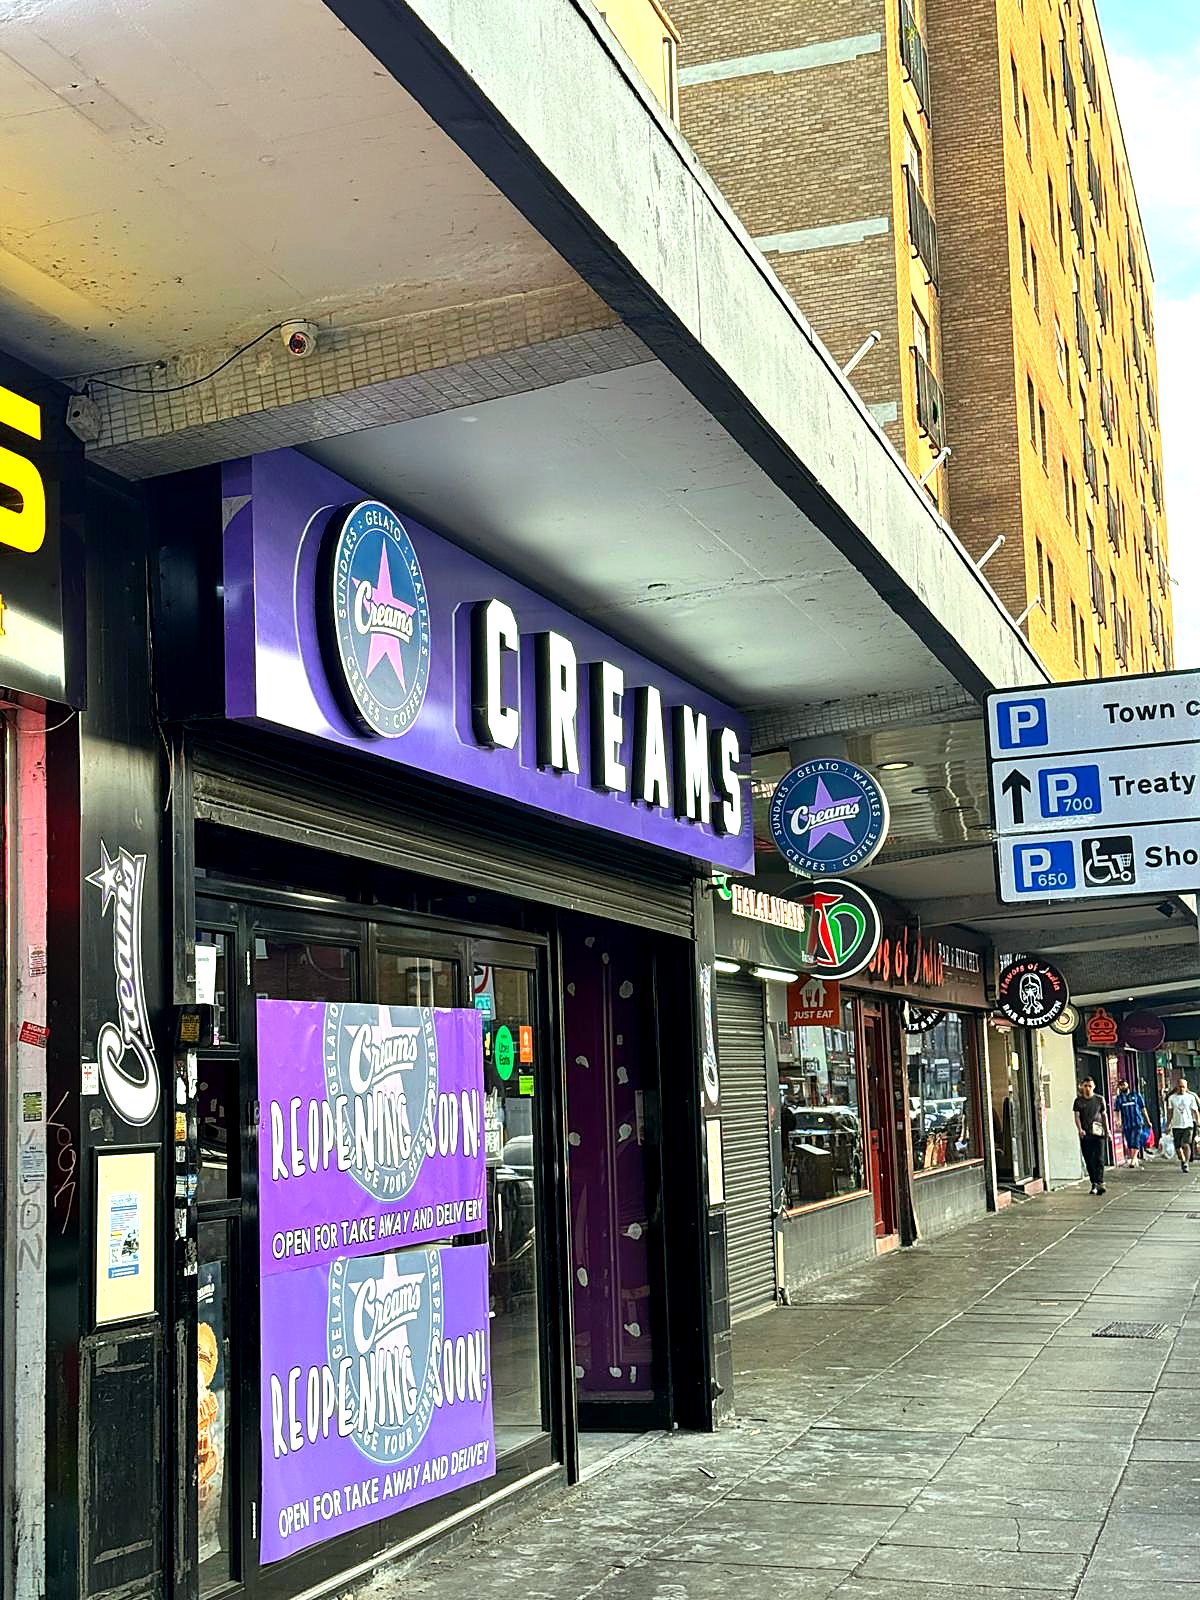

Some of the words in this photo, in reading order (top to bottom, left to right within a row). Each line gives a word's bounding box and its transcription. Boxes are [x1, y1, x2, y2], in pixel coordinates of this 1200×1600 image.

[365, 510, 401, 542] GELATO
[338, 527, 357, 619] SUNDAES
[354, 580, 414, 638] Creams
[410, 559, 428, 657] WAFFLES
[347, 656, 380, 722] CREPES
[393, 682, 423, 729] COFFEE
[485, 598, 743, 836] CREAMS
[1008, 703, 1040, 744] P
[1103, 702, 1175, 724] Town
[797, 763, 839, 778] GELATO
[852, 771, 880, 817] WAFFLES
[1046, 772, 1078, 813] P
[1063, 796, 1093, 811] 700
[1108, 770, 1196, 796] Treaty
[773, 786, 789, 836] SUNDAES
[790, 802, 860, 835] Creams
[786, 849, 825, 871] CREPES
[842, 832, 876, 867] COFFEE
[1021, 847, 1052, 888] P
[1037, 872, 1068, 886] 650
[98, 848, 160, 1126] Creams
[793, 1011, 814, 1021] JUST
[816, 1009, 834, 1019] EAT
[1002, 1003, 1018, 1021] BAR
[1018, 1016, 1025, 1025] &
[1026, 1000, 1062, 1026] KITCHEN
[327, 1003, 339, 1096] GELATO
[349, 1023, 418, 1094] Creams
[423, 1007, 437, 1089] CREPES
[270, 1091, 412, 1181] REOPENING
[426, 1088, 480, 1159] SOON!
[383, 1170, 407, 1194] YOUR
[272, 1228, 311, 1260] OPEN
[314, 1222, 338, 1250] FOR
[341, 1217, 376, 1246] TAKE
[378, 1210, 410, 1239] AWAY
[411, 1206, 434, 1232] AND
[436, 1199, 483, 1227] DELIVERY
[332, 1261, 343, 1359] GELATO
[353, 1278, 421, 1354] Creams
[429, 1249, 441, 1337] CREPES
[270, 1345, 418, 1459] REOPENING
[431, 1328, 488, 1408] SOON!
[384, 1427, 414, 1455] YOUR
[278, 1500, 310, 1538] OPEN
[313, 1492, 343, 1523] FOR
[344, 1477, 379, 1511] TAKE
[383, 1463, 421, 1500] AWAY
[421, 1455, 448, 1486] AND
